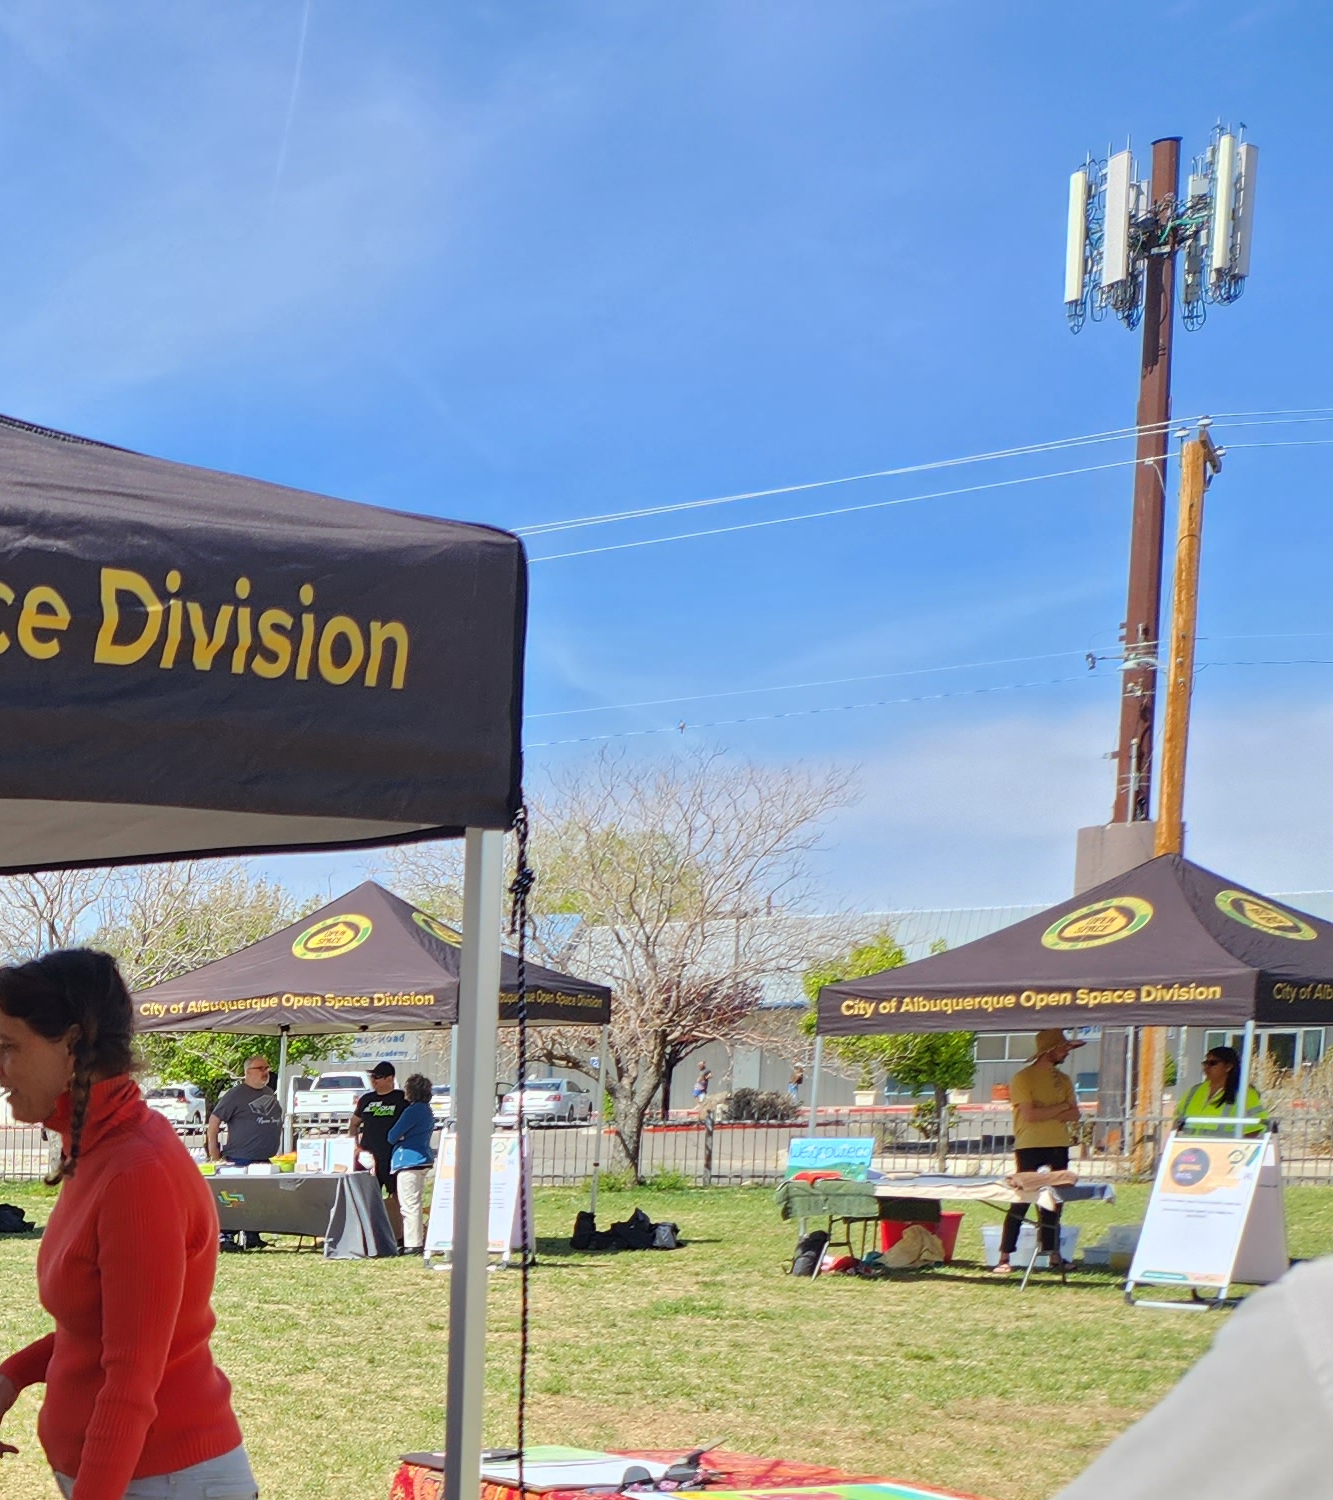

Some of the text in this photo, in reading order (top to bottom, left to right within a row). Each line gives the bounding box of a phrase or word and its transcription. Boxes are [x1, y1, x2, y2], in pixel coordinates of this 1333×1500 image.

[93, 567, 410, 691] Division
[139, 991, 434, 1019] City of Albuquerque Open Space Division
[841, 983, 1221, 1018] City of Albuquerque Open Space Division
[1272, 982, 1297, 1004] City
[1299, 983, 1313, 1000] of
